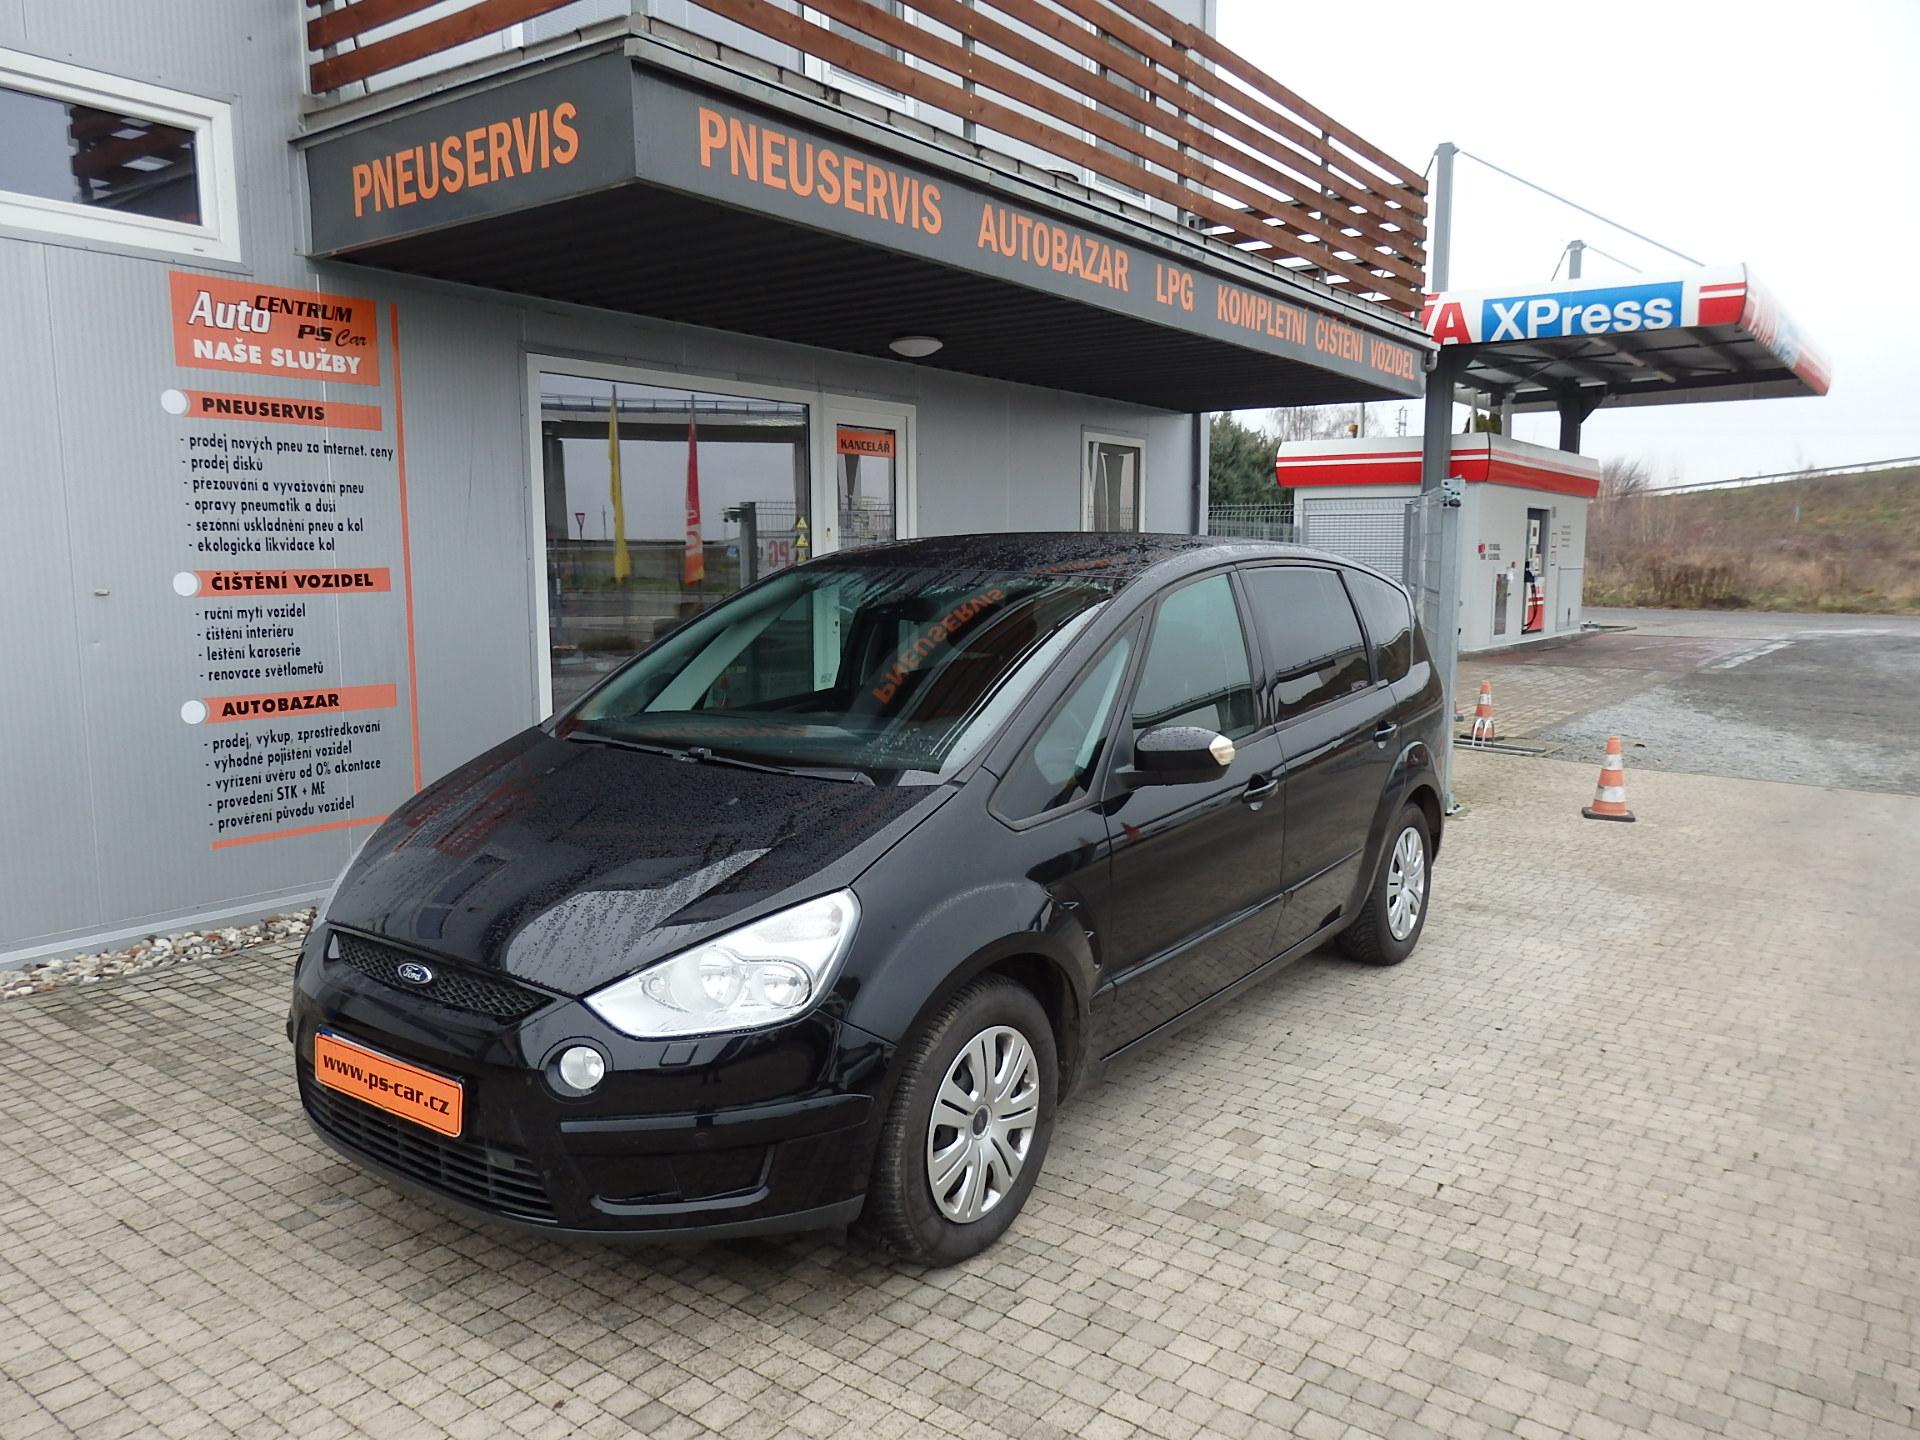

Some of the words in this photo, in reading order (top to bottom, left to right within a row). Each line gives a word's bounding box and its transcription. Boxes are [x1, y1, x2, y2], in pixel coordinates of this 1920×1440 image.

[352, 101, 580, 217] PNEUSERVIS
[698, 106, 943, 235] PNEUSERVIS
[977, 203, 1129, 292] AUTOBAZAR
[1156, 263, 1195, 312] LPG
[1216, 284, 1309, 346] KOMPLETNÍ
[1370, 340, 1415, 381] VOZIDEL
[187, 290, 272, 334] Auto
[254, 295, 353, 323] CENTRUM
[1489, 297, 1674, 341] XPress
[297, 324, 333, 341] PS
[334, 328, 368, 347] Car
[193, 338, 263, 364] NAŠE
[271, 347, 361, 375] SLUŽBY
[202, 397, 326, 421] PNEUSERVIS
[190, 433, 228, 452] prodej
[231, 436, 273, 453] nových
[277, 441, 303, 455] pneu
[307, 443, 320, 453] za
[323, 440, 368, 457] internet.
[370, 447, 394, 461] ceny
[841, 438, 890, 453] KANCELÁŘ
[191, 454, 230, 474] prodej
[233, 455, 263, 471] disků
[193, 476, 258, 493] přezouvání
[262, 481, 269, 491] a
[273, 480, 337, 496] vyvažování
[340, 484, 364, 497] pneu
[194, 500, 236, 515] opravy
[241, 497, 301, 515] pneumatik
[305, 502, 311, 512] a
[316, 497, 336, 512] duší
[196, 518, 240, 531] sezónní
[244, 517, 305, 532] uskladnění
[308, 521, 334, 535] pneu
[337, 521, 344, 532] a
[347, 517, 364, 532] kol
[198, 536, 261, 556] ekologická
[265, 536, 315, 552] likvidace
[318, 537, 335, 551] kol
[211, 570, 288, 591] ČIŠTĚNÍ
[293, 573, 374, 589] VOZIDEL
[204, 606, 233, 620] ruční
[267, 602, 306, 618] vozidel
[206, 626, 243, 640] čištění
[246, 623, 294, 639] interiéru
[207, 646, 245, 661] leštění
[249, 642, 301, 659] karoserie
[208, 668, 261, 681] renovace
[265, 661, 324, 678] světlometů
[221, 693, 340, 717] AUTOBAZAR
[213, 732, 252, 753] prodej,
[256, 729, 293, 748] výkup,
[297, 720, 381, 743] zprostředkování
[214, 751, 264, 773] výhodné
[267, 746, 312, 767] pojištění
[315, 739, 352, 757] vozidel
[215, 771, 262, 792] vyřízení
[265, 769, 296, 783] úvěru
[299, 763, 312, 778] od
[316, 761, 331, 776] 0%
[334, 759, 381, 774] akontace
[217, 789, 273, 813] provedení
[277, 784, 298, 801] STK
[302, 787, 307, 795] +
[311, 781, 325, 796] ME
[218, 809, 272, 833] prověření
[276, 802, 314, 823] původu
[318, 795, 355, 813] vozidel
[402, 965, 423, 982] Ford
[322, 1054, 450, 1116] www.ps-car.cz
